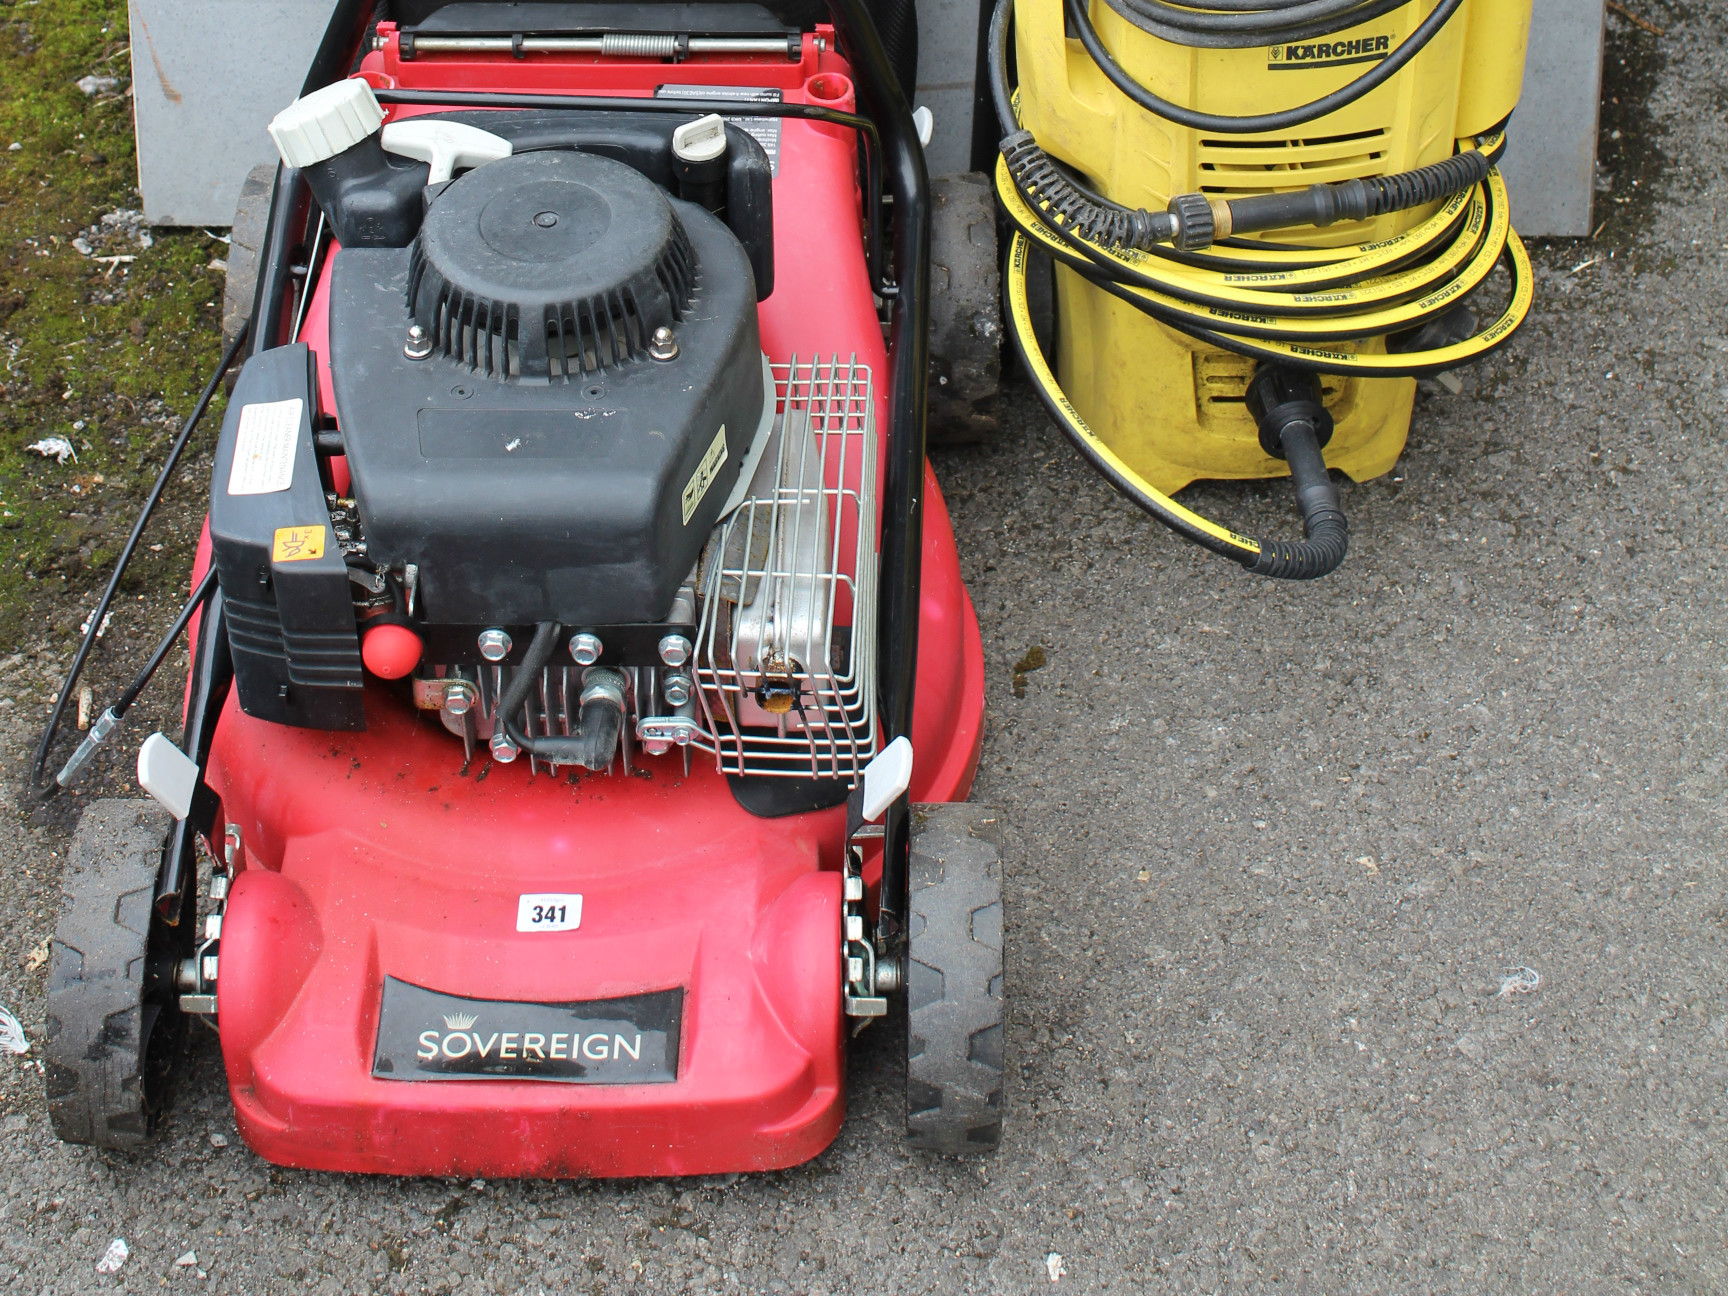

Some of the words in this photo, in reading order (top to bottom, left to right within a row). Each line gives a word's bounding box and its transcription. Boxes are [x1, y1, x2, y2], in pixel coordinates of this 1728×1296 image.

[1286, 36, 1389, 60] KÄRCHER
[1358, 235, 1404, 252] KÄRCHER
[1293, 294, 1347, 302] KÄRCHER
[1418, 283, 1461, 309] KÄRCHER
[1209, 307, 1266, 324] KÄRCHER
[1483, 318, 1513, 342] KÄRCHER
[1290, 345, 1348, 361] KÄRCHER
[283, 417, 294, 441] CLEANER
[276, 442, 289, 486] MAINTENANCE
[532, 905, 566, 923] 341
[416, 1030, 641, 1061] SOVEREIGN
